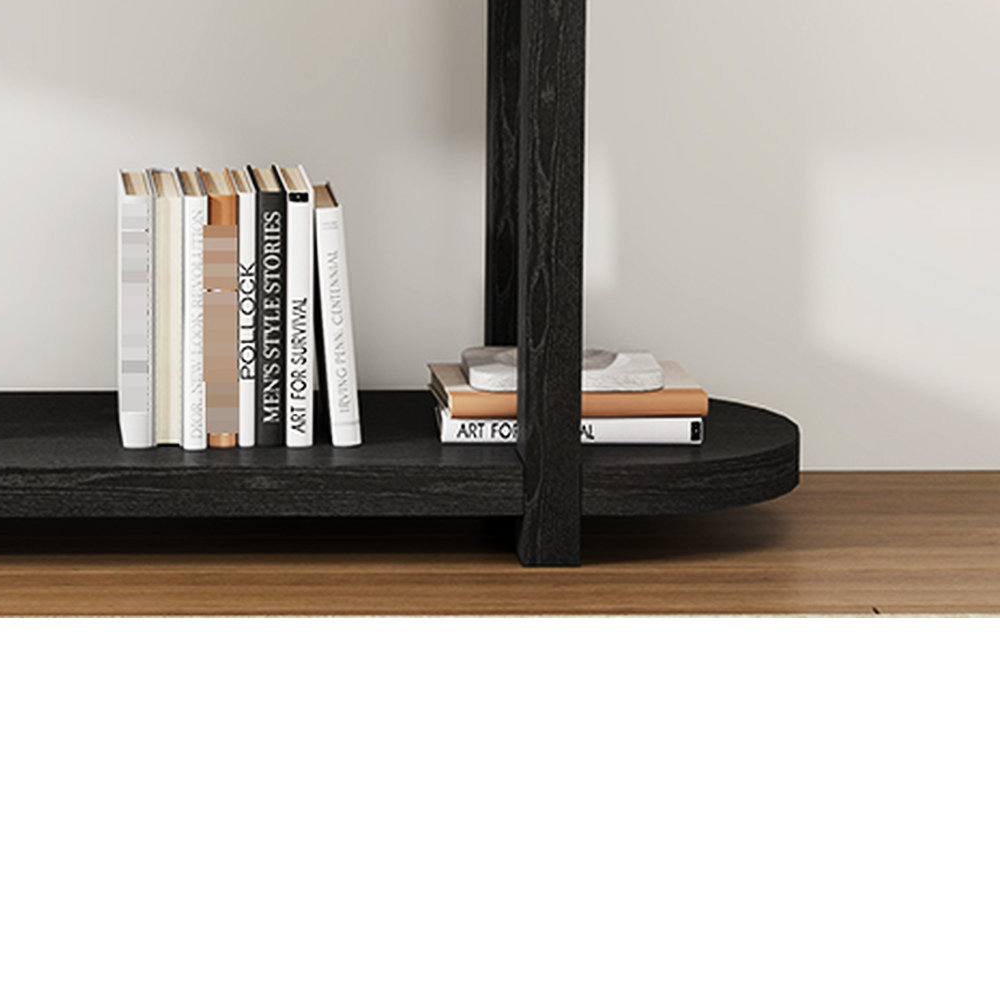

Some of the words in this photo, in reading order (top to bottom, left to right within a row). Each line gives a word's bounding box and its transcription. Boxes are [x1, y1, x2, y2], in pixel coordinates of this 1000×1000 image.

[262, 210, 283, 294] STORIES
[327, 250, 344, 326] CENTENNIAL
[238, 262, 257, 381] POLLOCK
[262, 296, 283, 360] STYLE
[290, 297, 308, 365] SURVIVAL
[262, 363, 283, 423] MEN'S
[290, 370, 308, 401] FOR
[333, 368, 351, 414] IRVING
[290, 406, 308, 434] ART
[456, 422, 485, 439] ART
